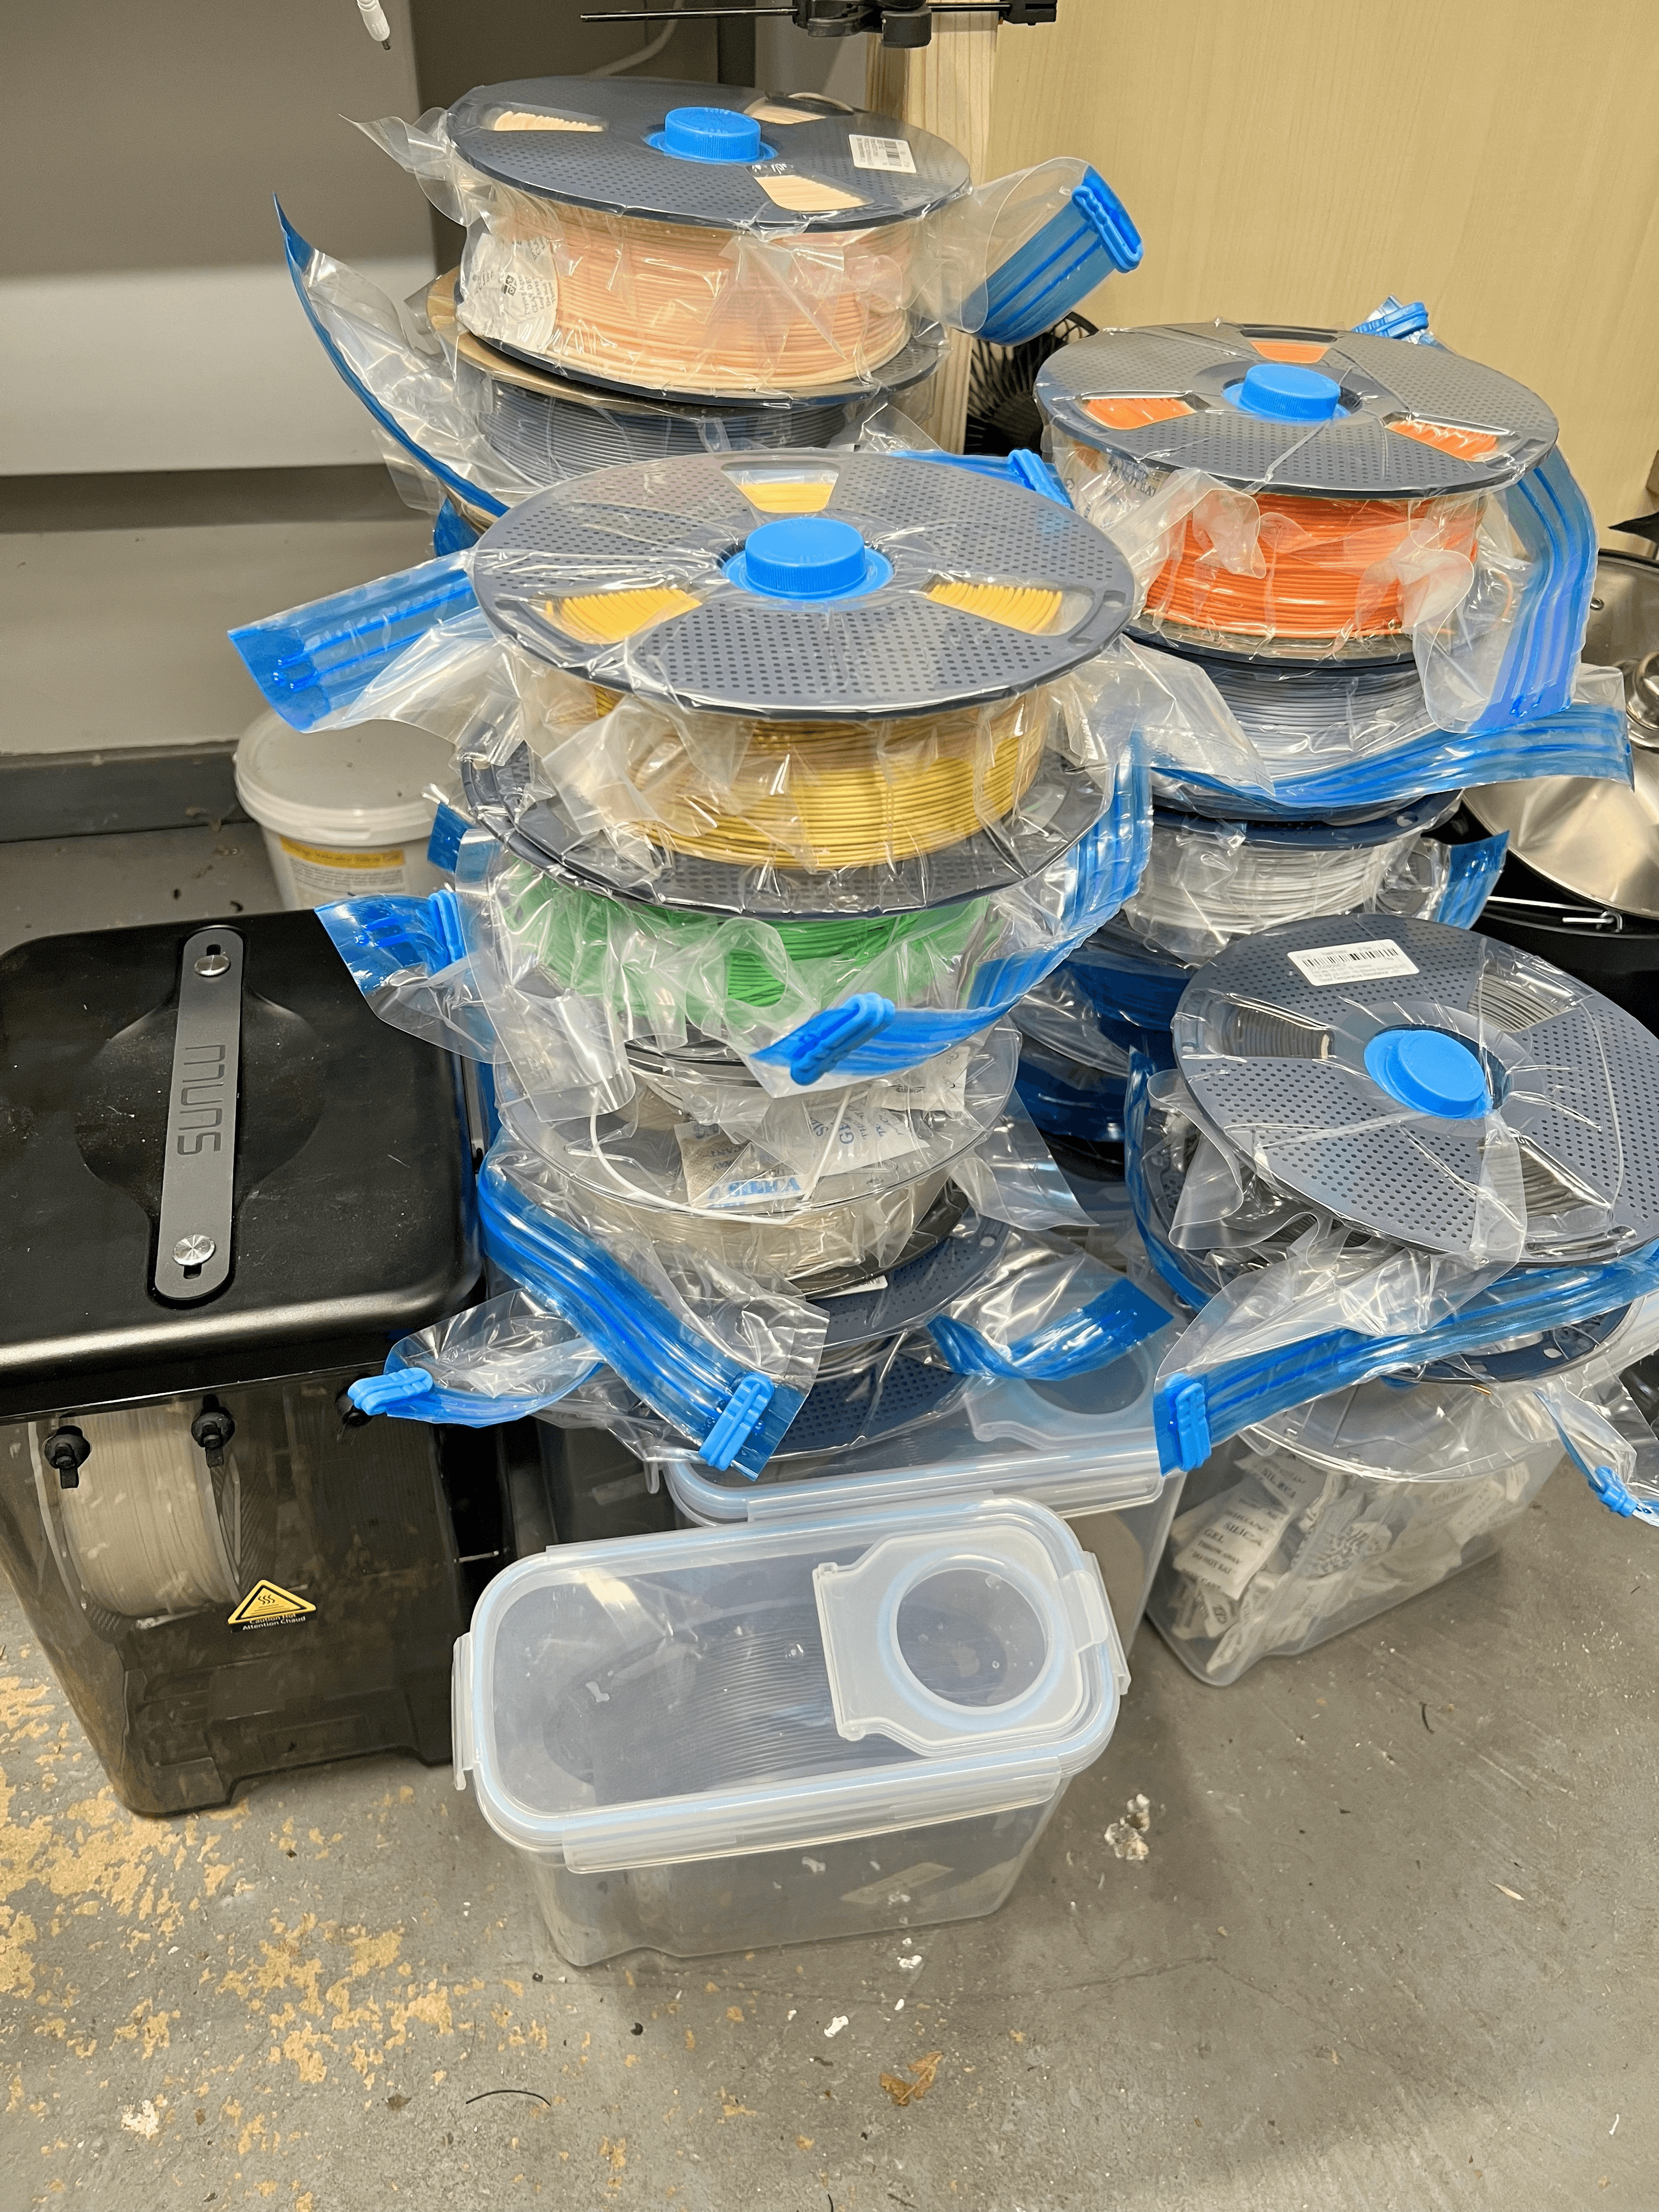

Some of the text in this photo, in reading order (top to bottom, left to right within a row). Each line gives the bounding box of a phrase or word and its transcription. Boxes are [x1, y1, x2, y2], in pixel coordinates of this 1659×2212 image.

[177, 1045, 225, 1155] SUNLU
[1204, 1528, 1224, 1543] GEL
[242, 1616, 306, 1630] Attention Chaud
